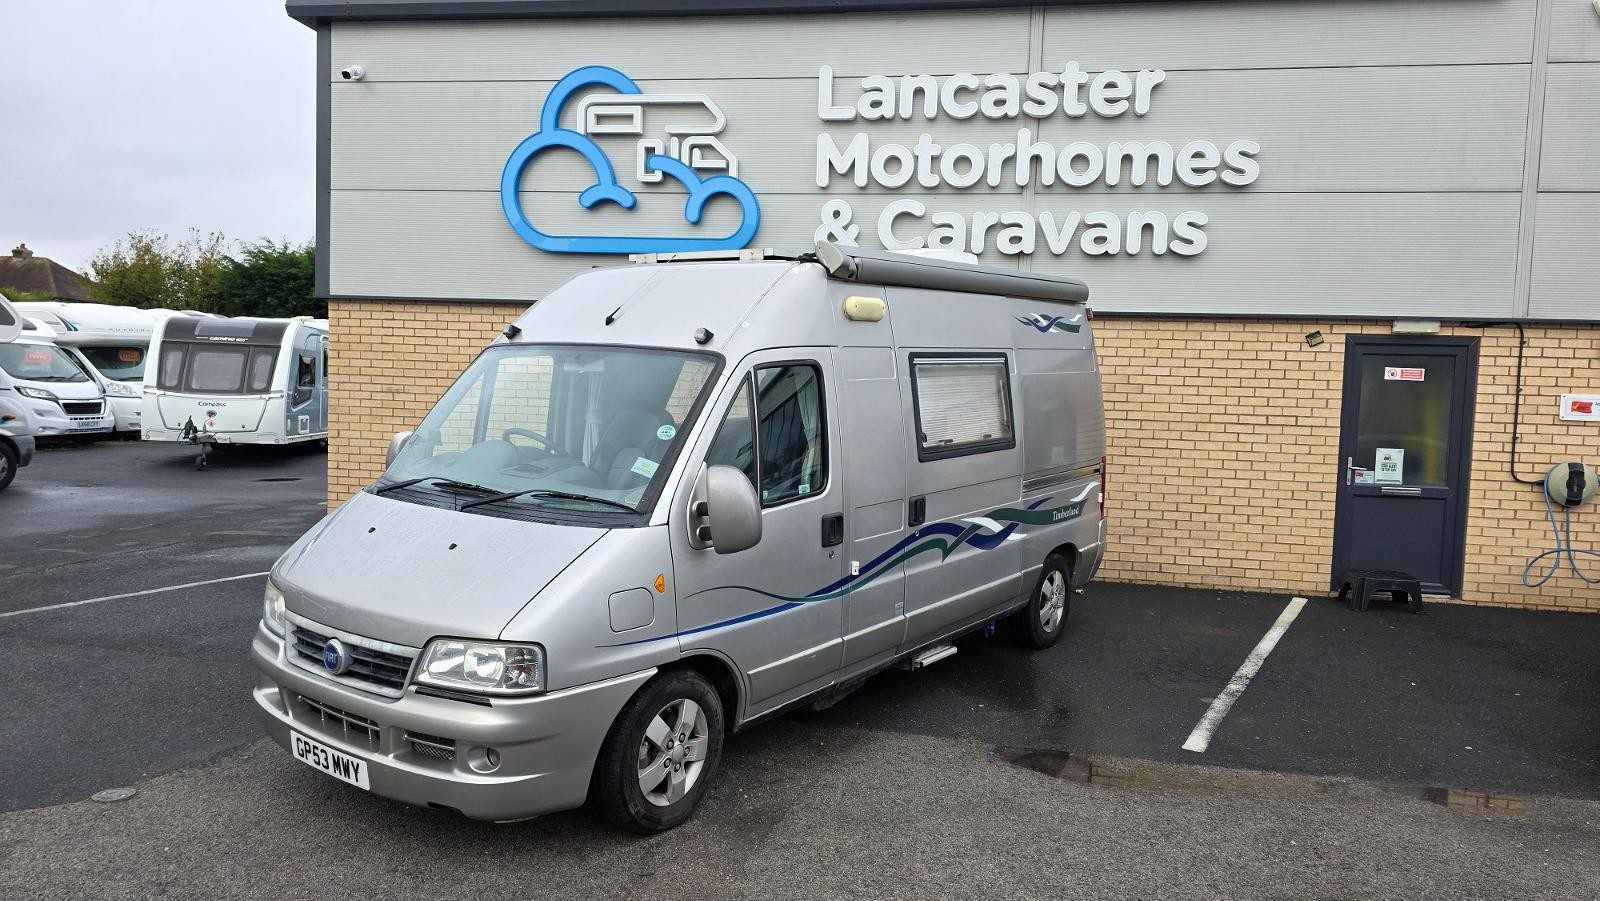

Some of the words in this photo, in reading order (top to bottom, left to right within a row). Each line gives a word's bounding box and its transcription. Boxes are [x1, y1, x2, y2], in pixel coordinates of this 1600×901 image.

[817, 60, 1165, 121] Lancaster
[815, 127, 1261, 188] Motorhomes
[814, 199, 859, 250] &
[878, 198, 1209, 257] Caravans
[1053, 505, 1080, 520] Timberland
[296, 737, 329, 770] GP53
[332, 753, 360, 782] MWY
